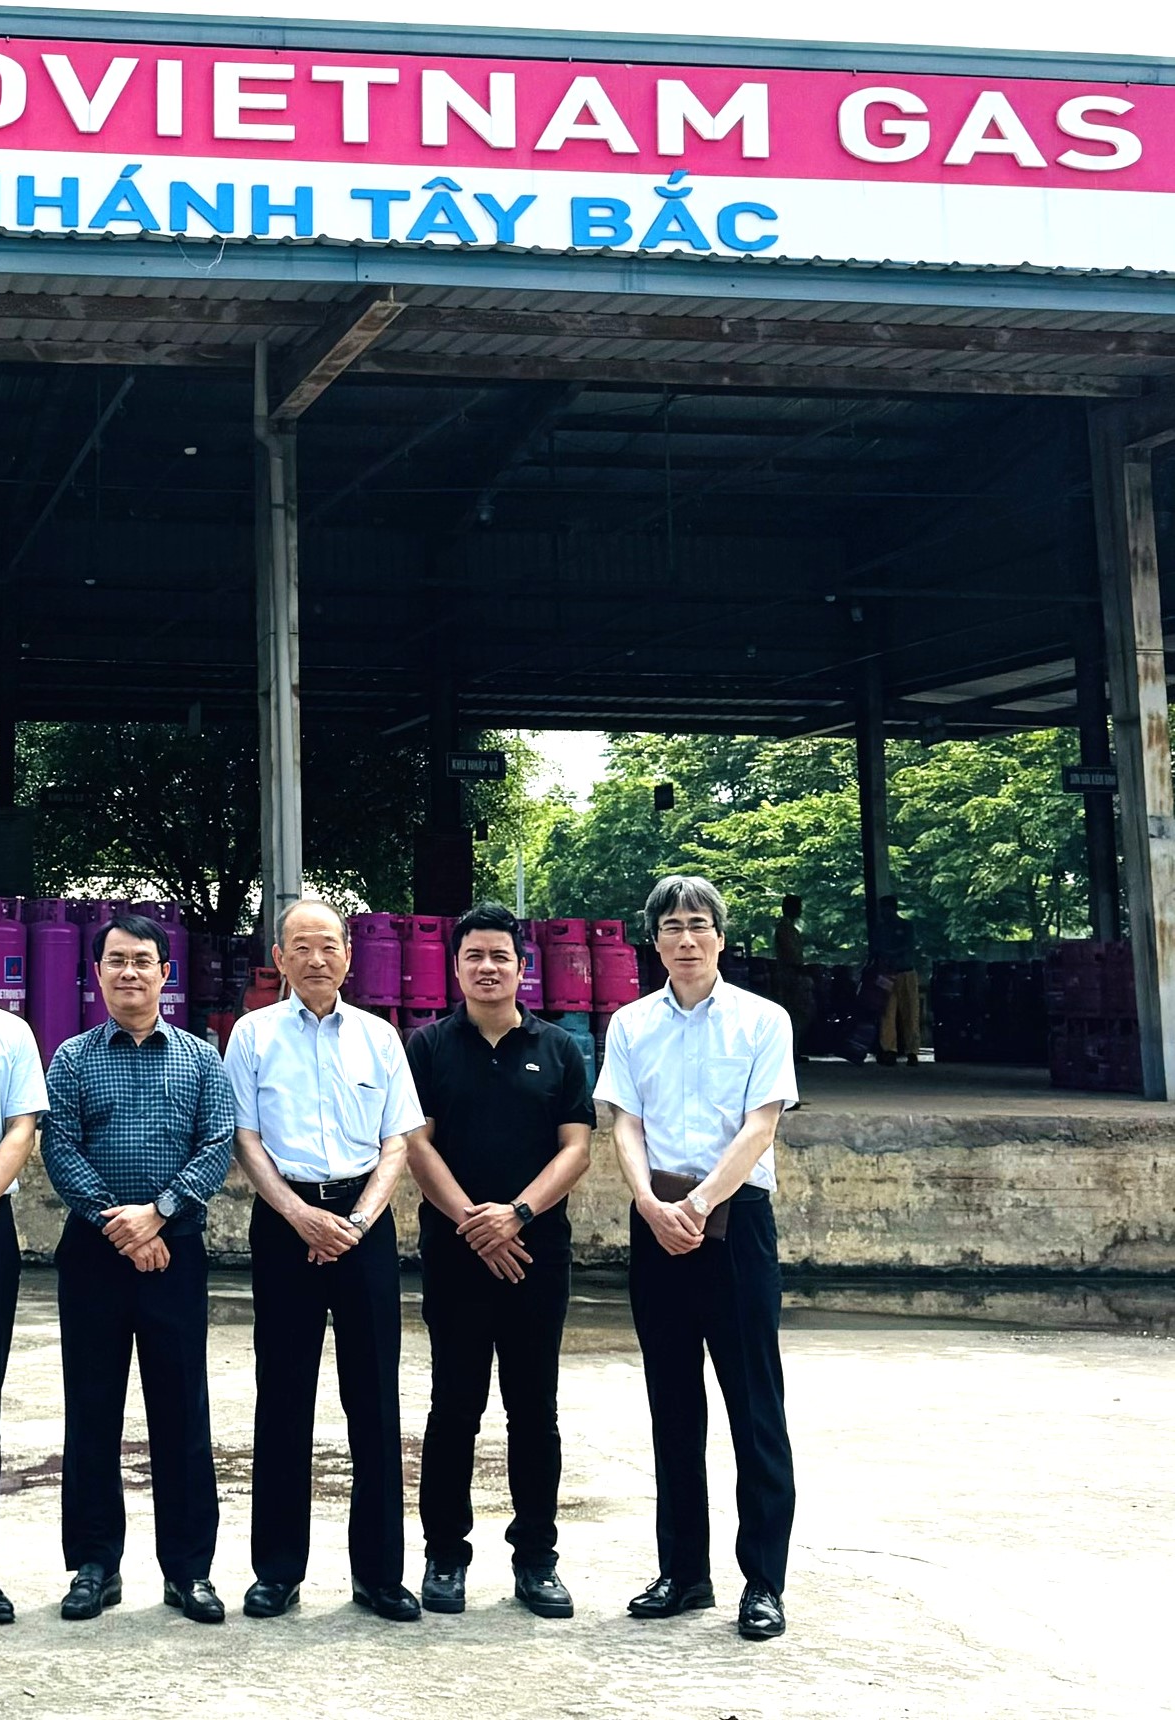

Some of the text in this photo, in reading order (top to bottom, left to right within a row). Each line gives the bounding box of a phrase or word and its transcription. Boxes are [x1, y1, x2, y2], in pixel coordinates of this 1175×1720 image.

[838, 86, 1144, 171] GAS
[350, 176, 538, 244] TÂY
[570, 169, 779, 252] BẮC
